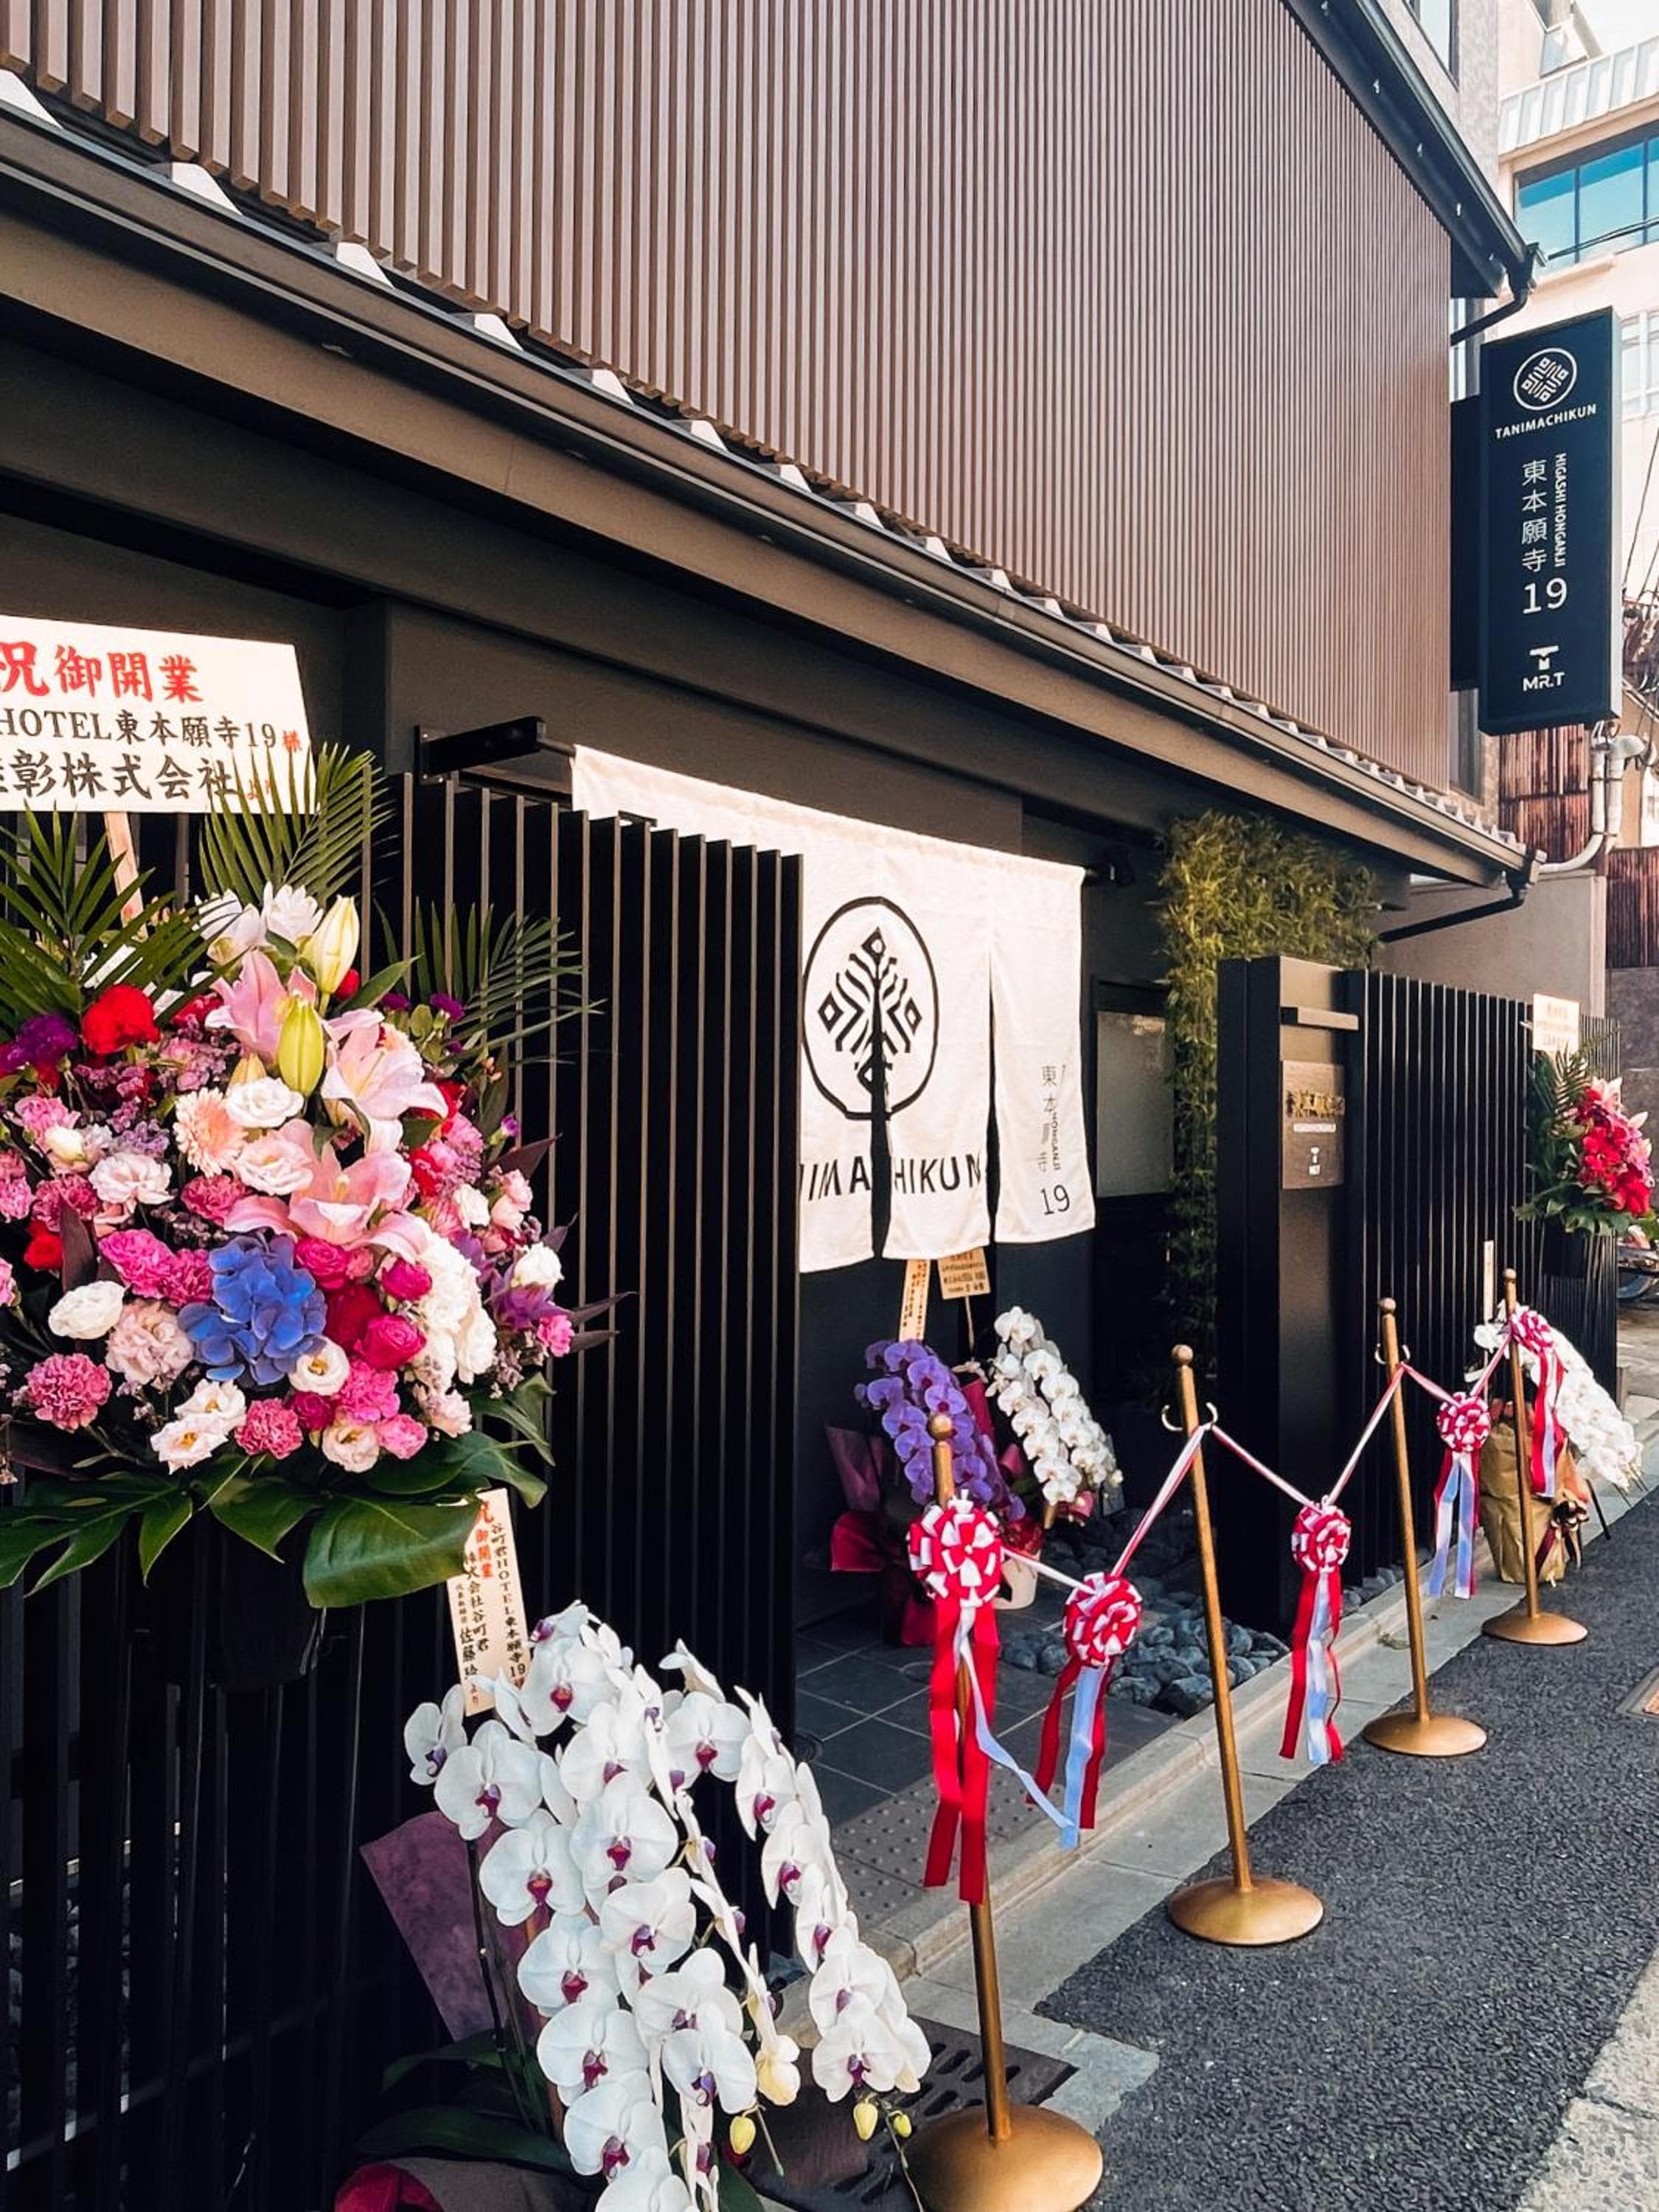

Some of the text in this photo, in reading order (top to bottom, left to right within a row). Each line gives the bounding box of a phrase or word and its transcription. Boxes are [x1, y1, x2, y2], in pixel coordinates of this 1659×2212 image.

[1495, 403, 1597, 439] TANIMACHIKUN
[1521, 459, 1548, 573] 東本願寺
[1554, 452, 1568, 567] HIGASHI HONGANJI
[1523, 577, 1568, 614] 19
[1522, 672, 1565, 692] MR.T
[0, 748, 237, 801] 彰株式会社
[1040, 1184, 1070, 1215] 19
